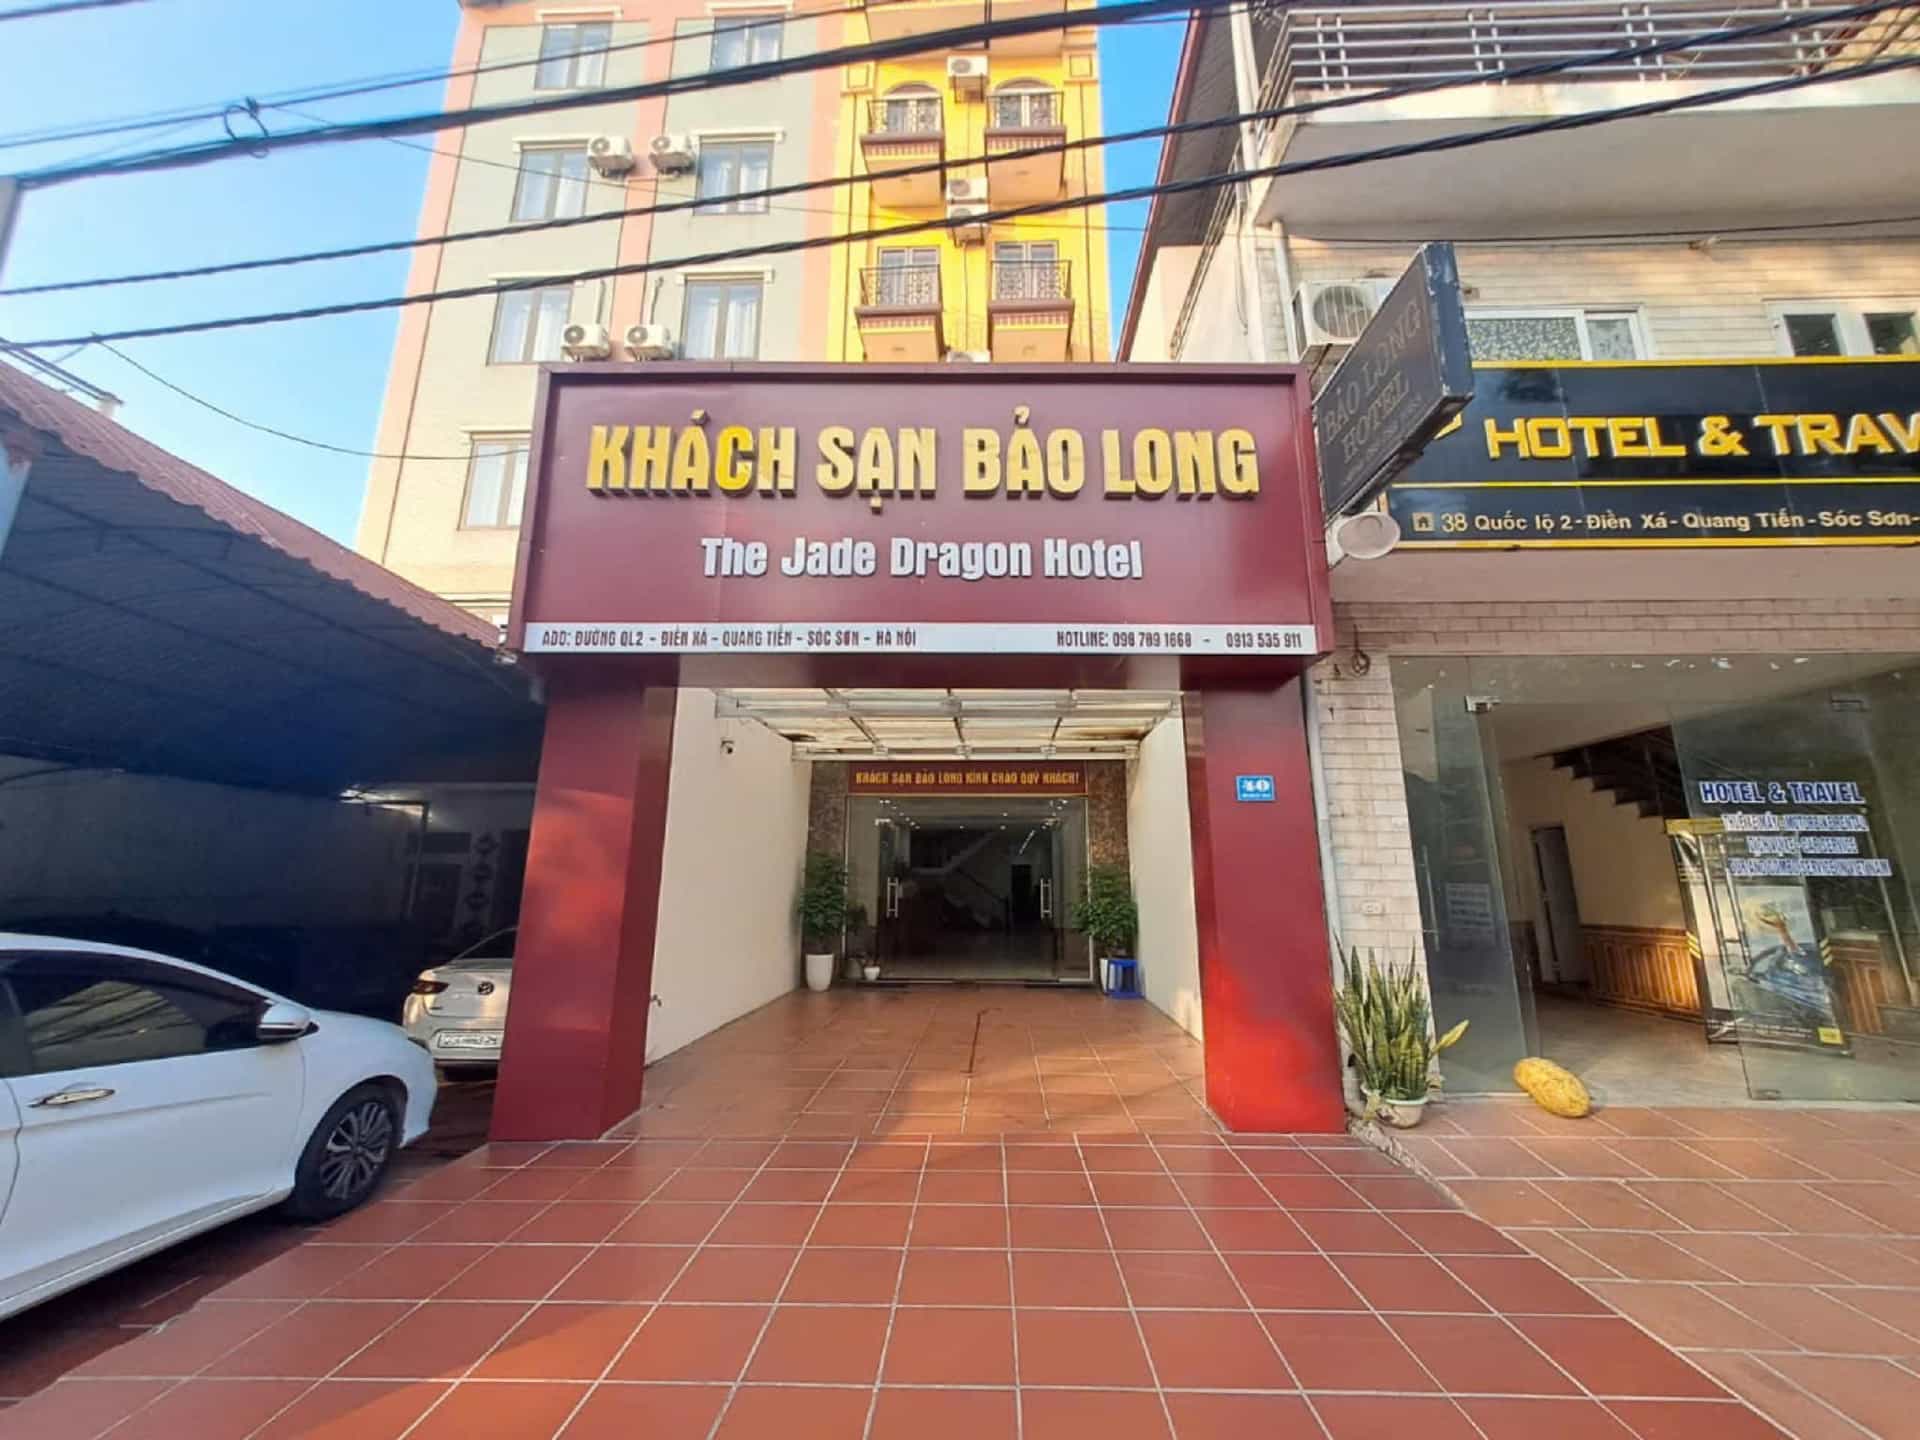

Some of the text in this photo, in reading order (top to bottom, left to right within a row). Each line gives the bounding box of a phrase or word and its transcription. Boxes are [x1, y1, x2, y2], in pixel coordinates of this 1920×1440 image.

[1363, 301, 1423, 395] LONG
[1341, 370, 1411, 465] HOTEL
[1484, 416, 1687, 459] HOTEL
[1697, 415, 1750, 457] &
[586, 409, 796, 498] KHÁCH
[816, 426, 938, 514] SẠN
[963, 405, 1087, 500] BẢO
[1101, 427, 1261, 500] LONG
[1440, 512, 1468, 533] 38
[1474, 509, 1529, 531] Quốc
[701, 537, 1144, 581] The Jade Dragon Hotel
[620, 630, 644, 647] QL2
[722, 630, 763, 647] QUANG
[1056, 630, 1109, 647] HOTLINE:
[1225, 632, 1254, 648] 0913
[1257, 632, 1281, 648] 535
[1283, 632, 1302, 648] 911
[1701, 781, 1867, 804] HOTEL & TRAVEL
